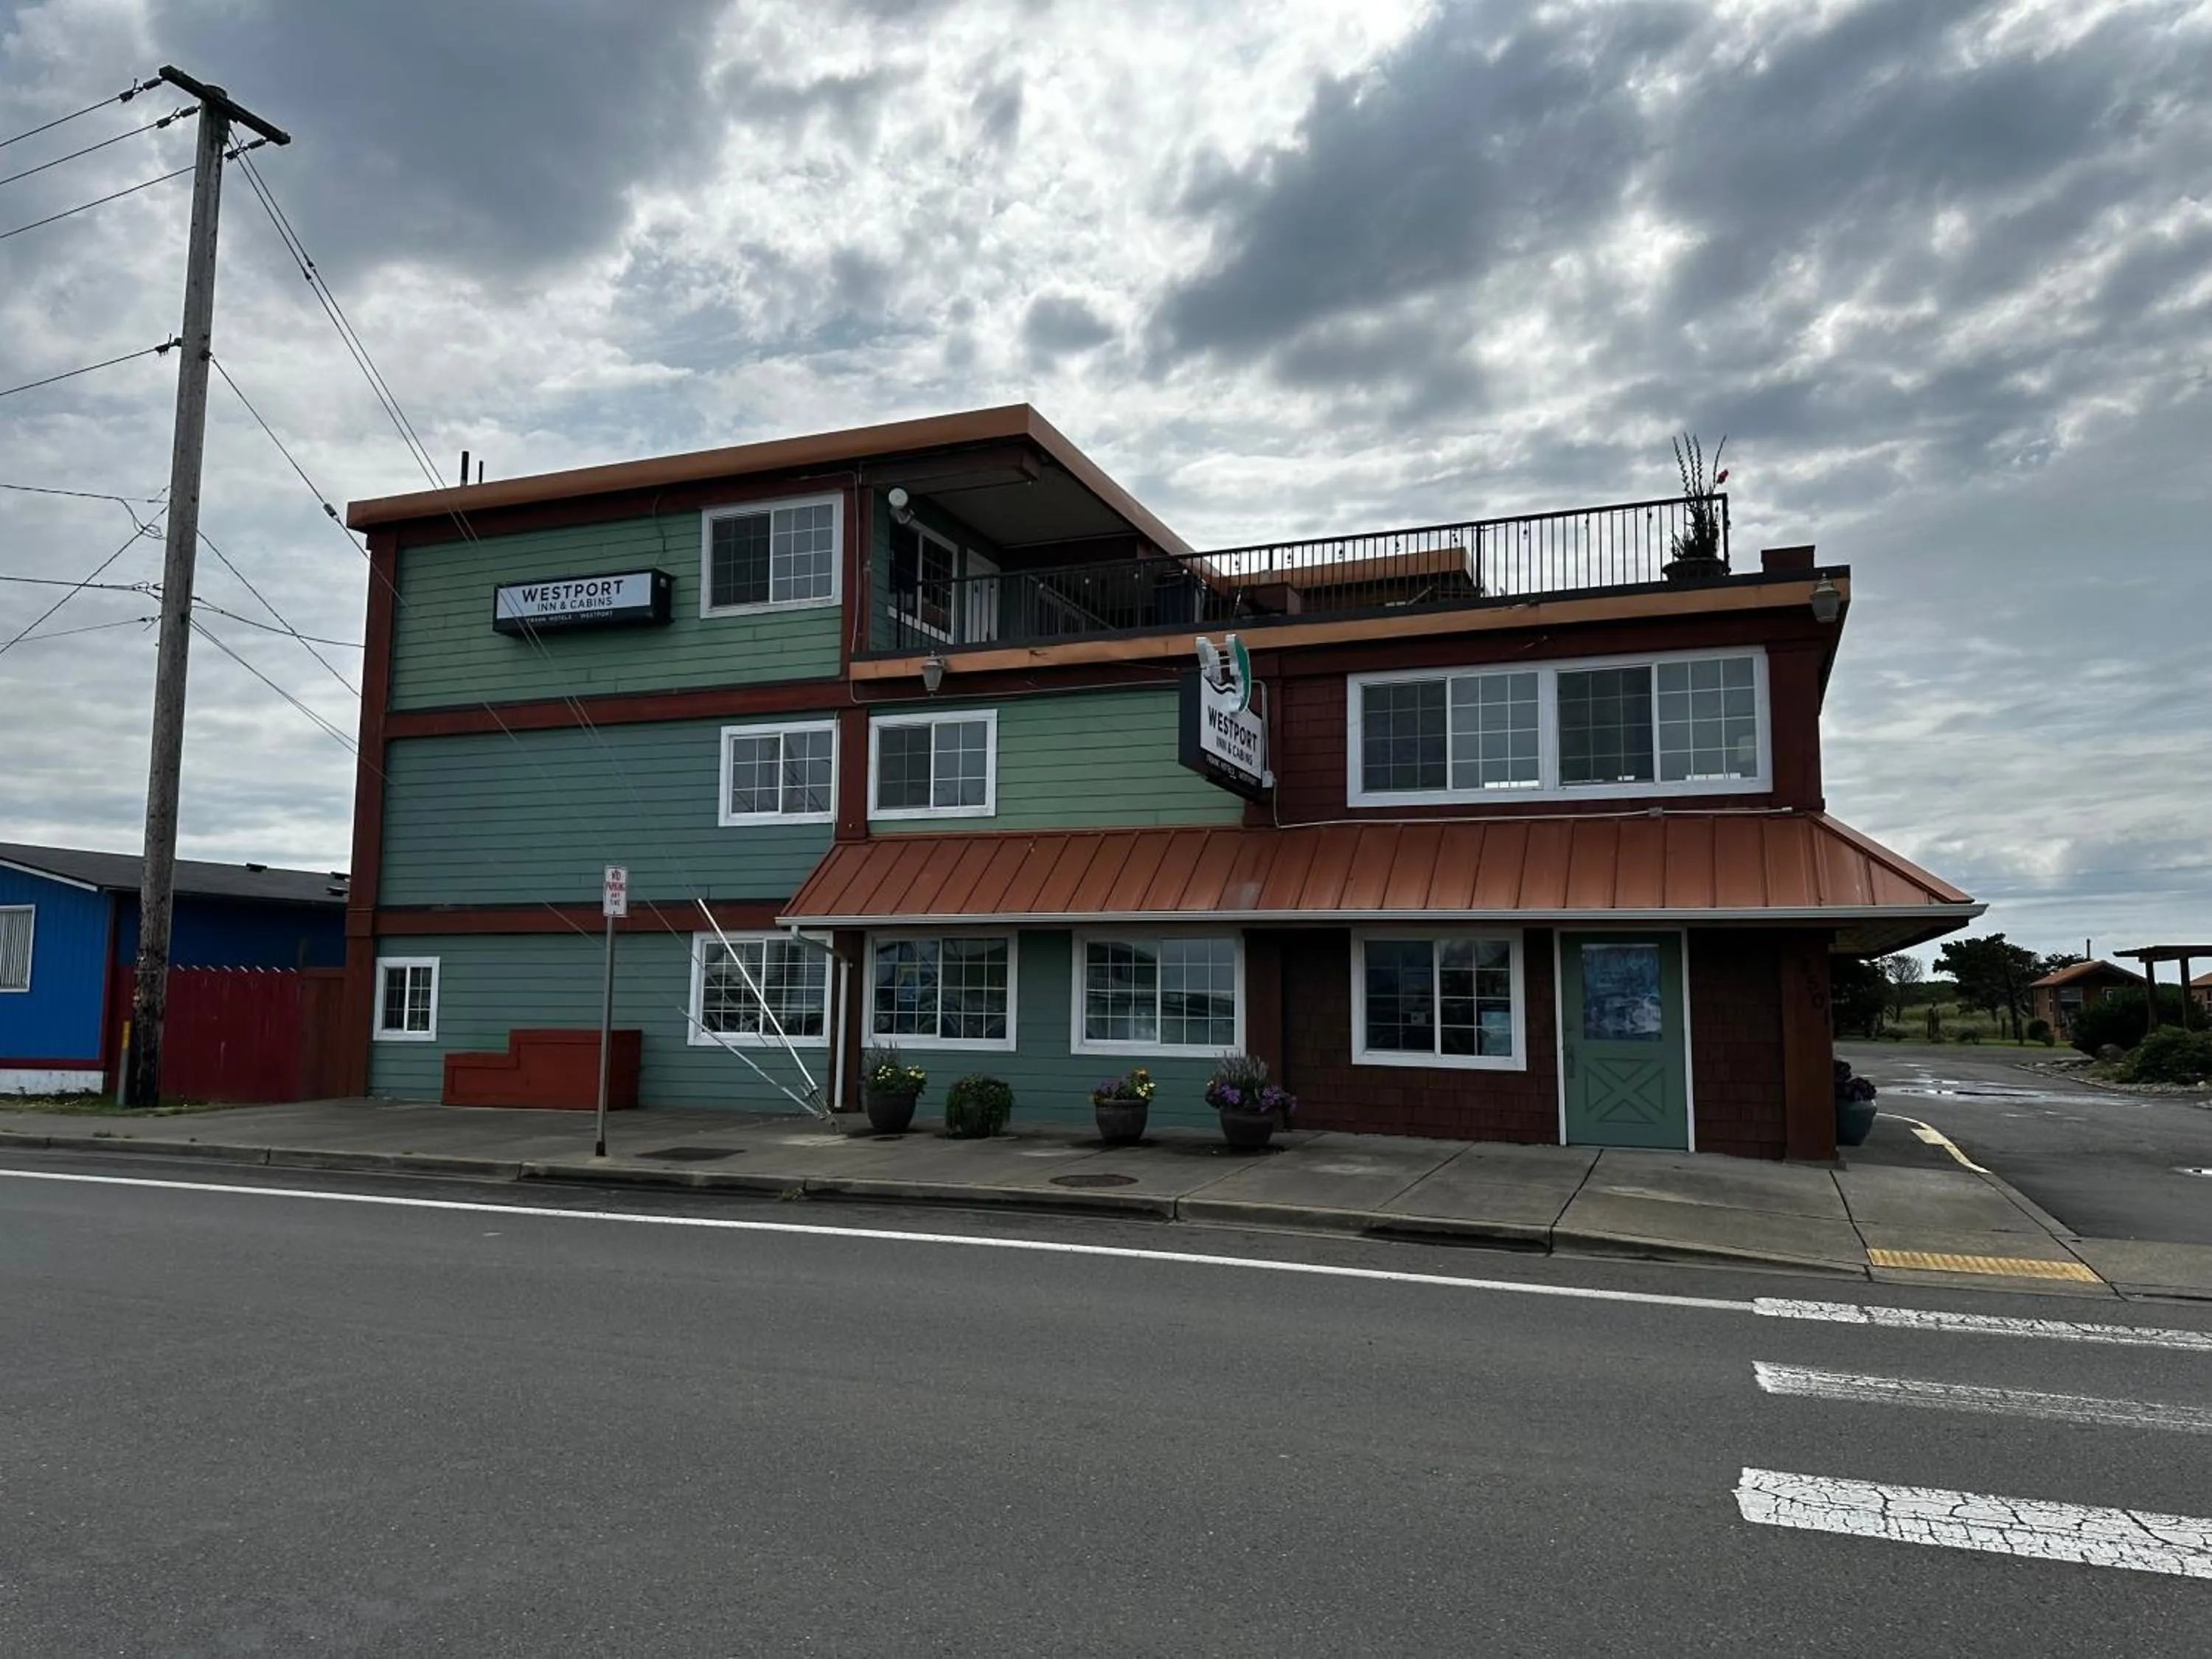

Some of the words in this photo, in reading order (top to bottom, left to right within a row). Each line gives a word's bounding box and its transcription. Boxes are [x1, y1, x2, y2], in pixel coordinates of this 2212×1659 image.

[522, 580, 624, 603] WESTPORT
[537, 602, 557, 612] INN
[560, 602, 567, 610] &
[570, 597, 613, 609] CABINS
[1207, 704, 1257, 752] WESTPORT
[1217, 735, 1227, 753] INN
[1228, 742, 1232, 754] &
[1233, 745, 1253, 766] CABINS
[611, 870, 622, 880] NO
